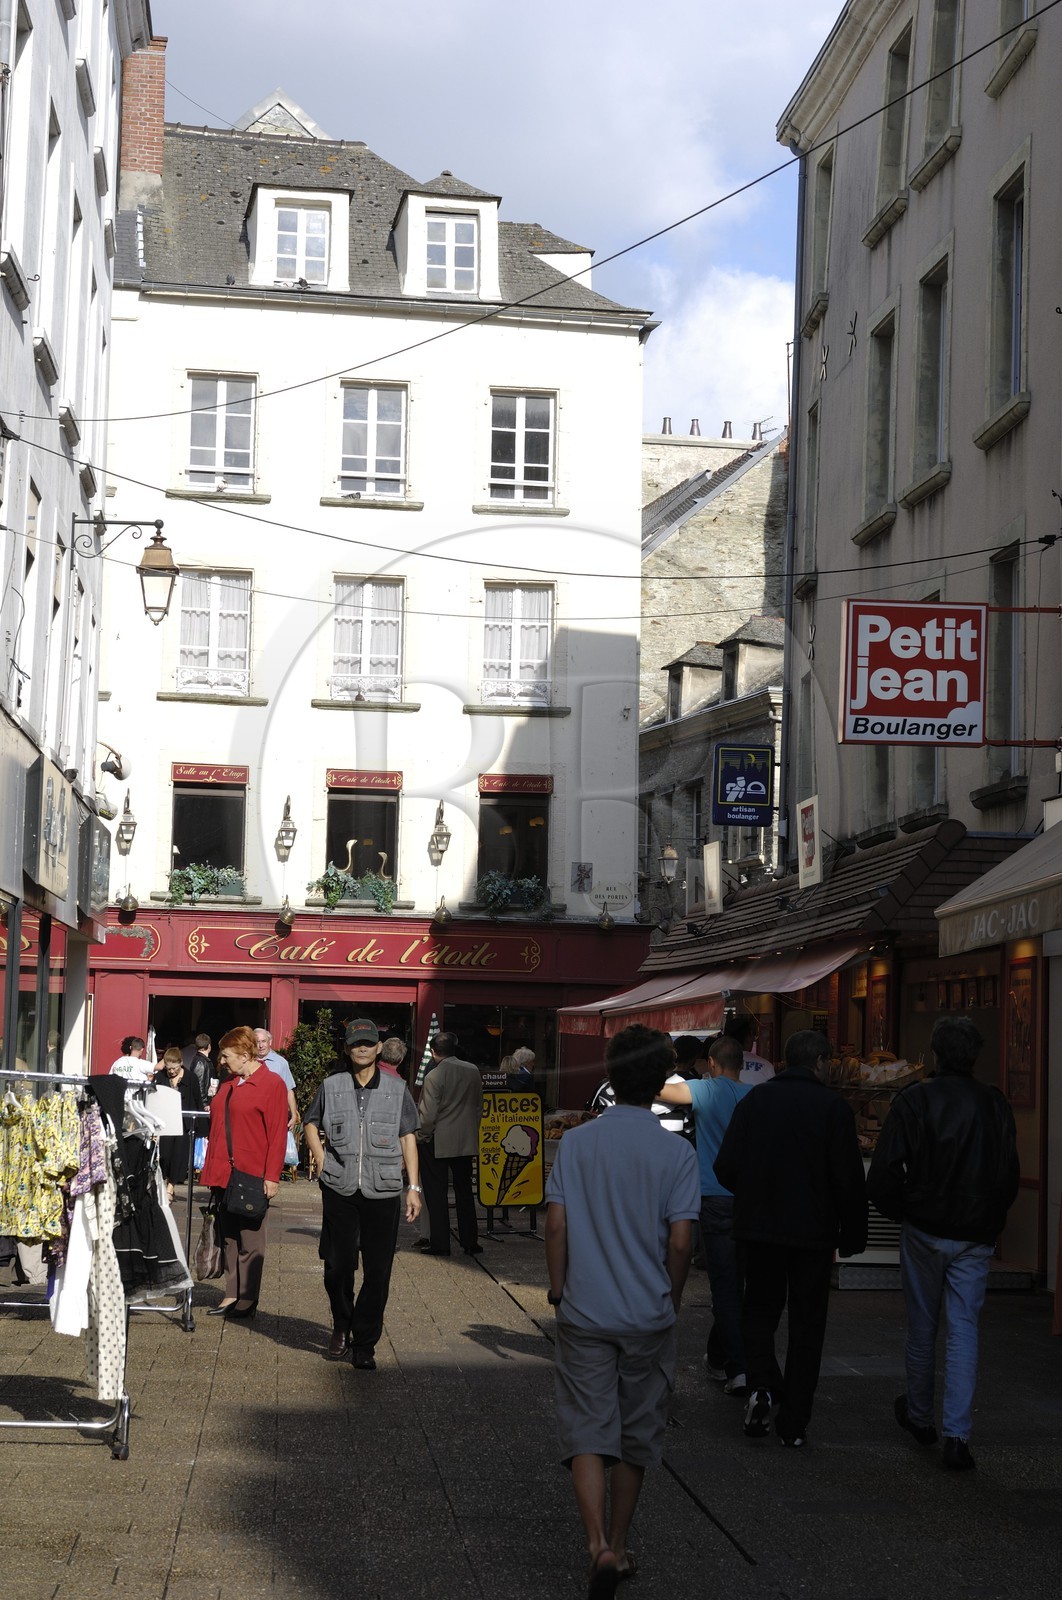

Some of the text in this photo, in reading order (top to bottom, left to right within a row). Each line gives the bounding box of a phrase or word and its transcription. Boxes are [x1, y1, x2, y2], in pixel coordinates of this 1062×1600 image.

[857, 614, 978, 661] Petit
[850, 656, 969, 710] jean
[852, 717, 978, 740] Boulanger
[176, 766, 197, 775] Salle
[337, 774, 358, 783] Café
[370, 776, 392, 784] l'étoile
[731, 805, 756, 813] artisan
[727, 812, 760, 821] boulanger
[234, 932, 499, 967] Café de l'étoile
[481, 1093, 540, 1119] glaces
[490, 1113, 496, 1123] à
[481, 1124, 501, 1132] simple
[482, 1132, 500, 1143] 2€
[481, 1153, 500, 1166] 3€
